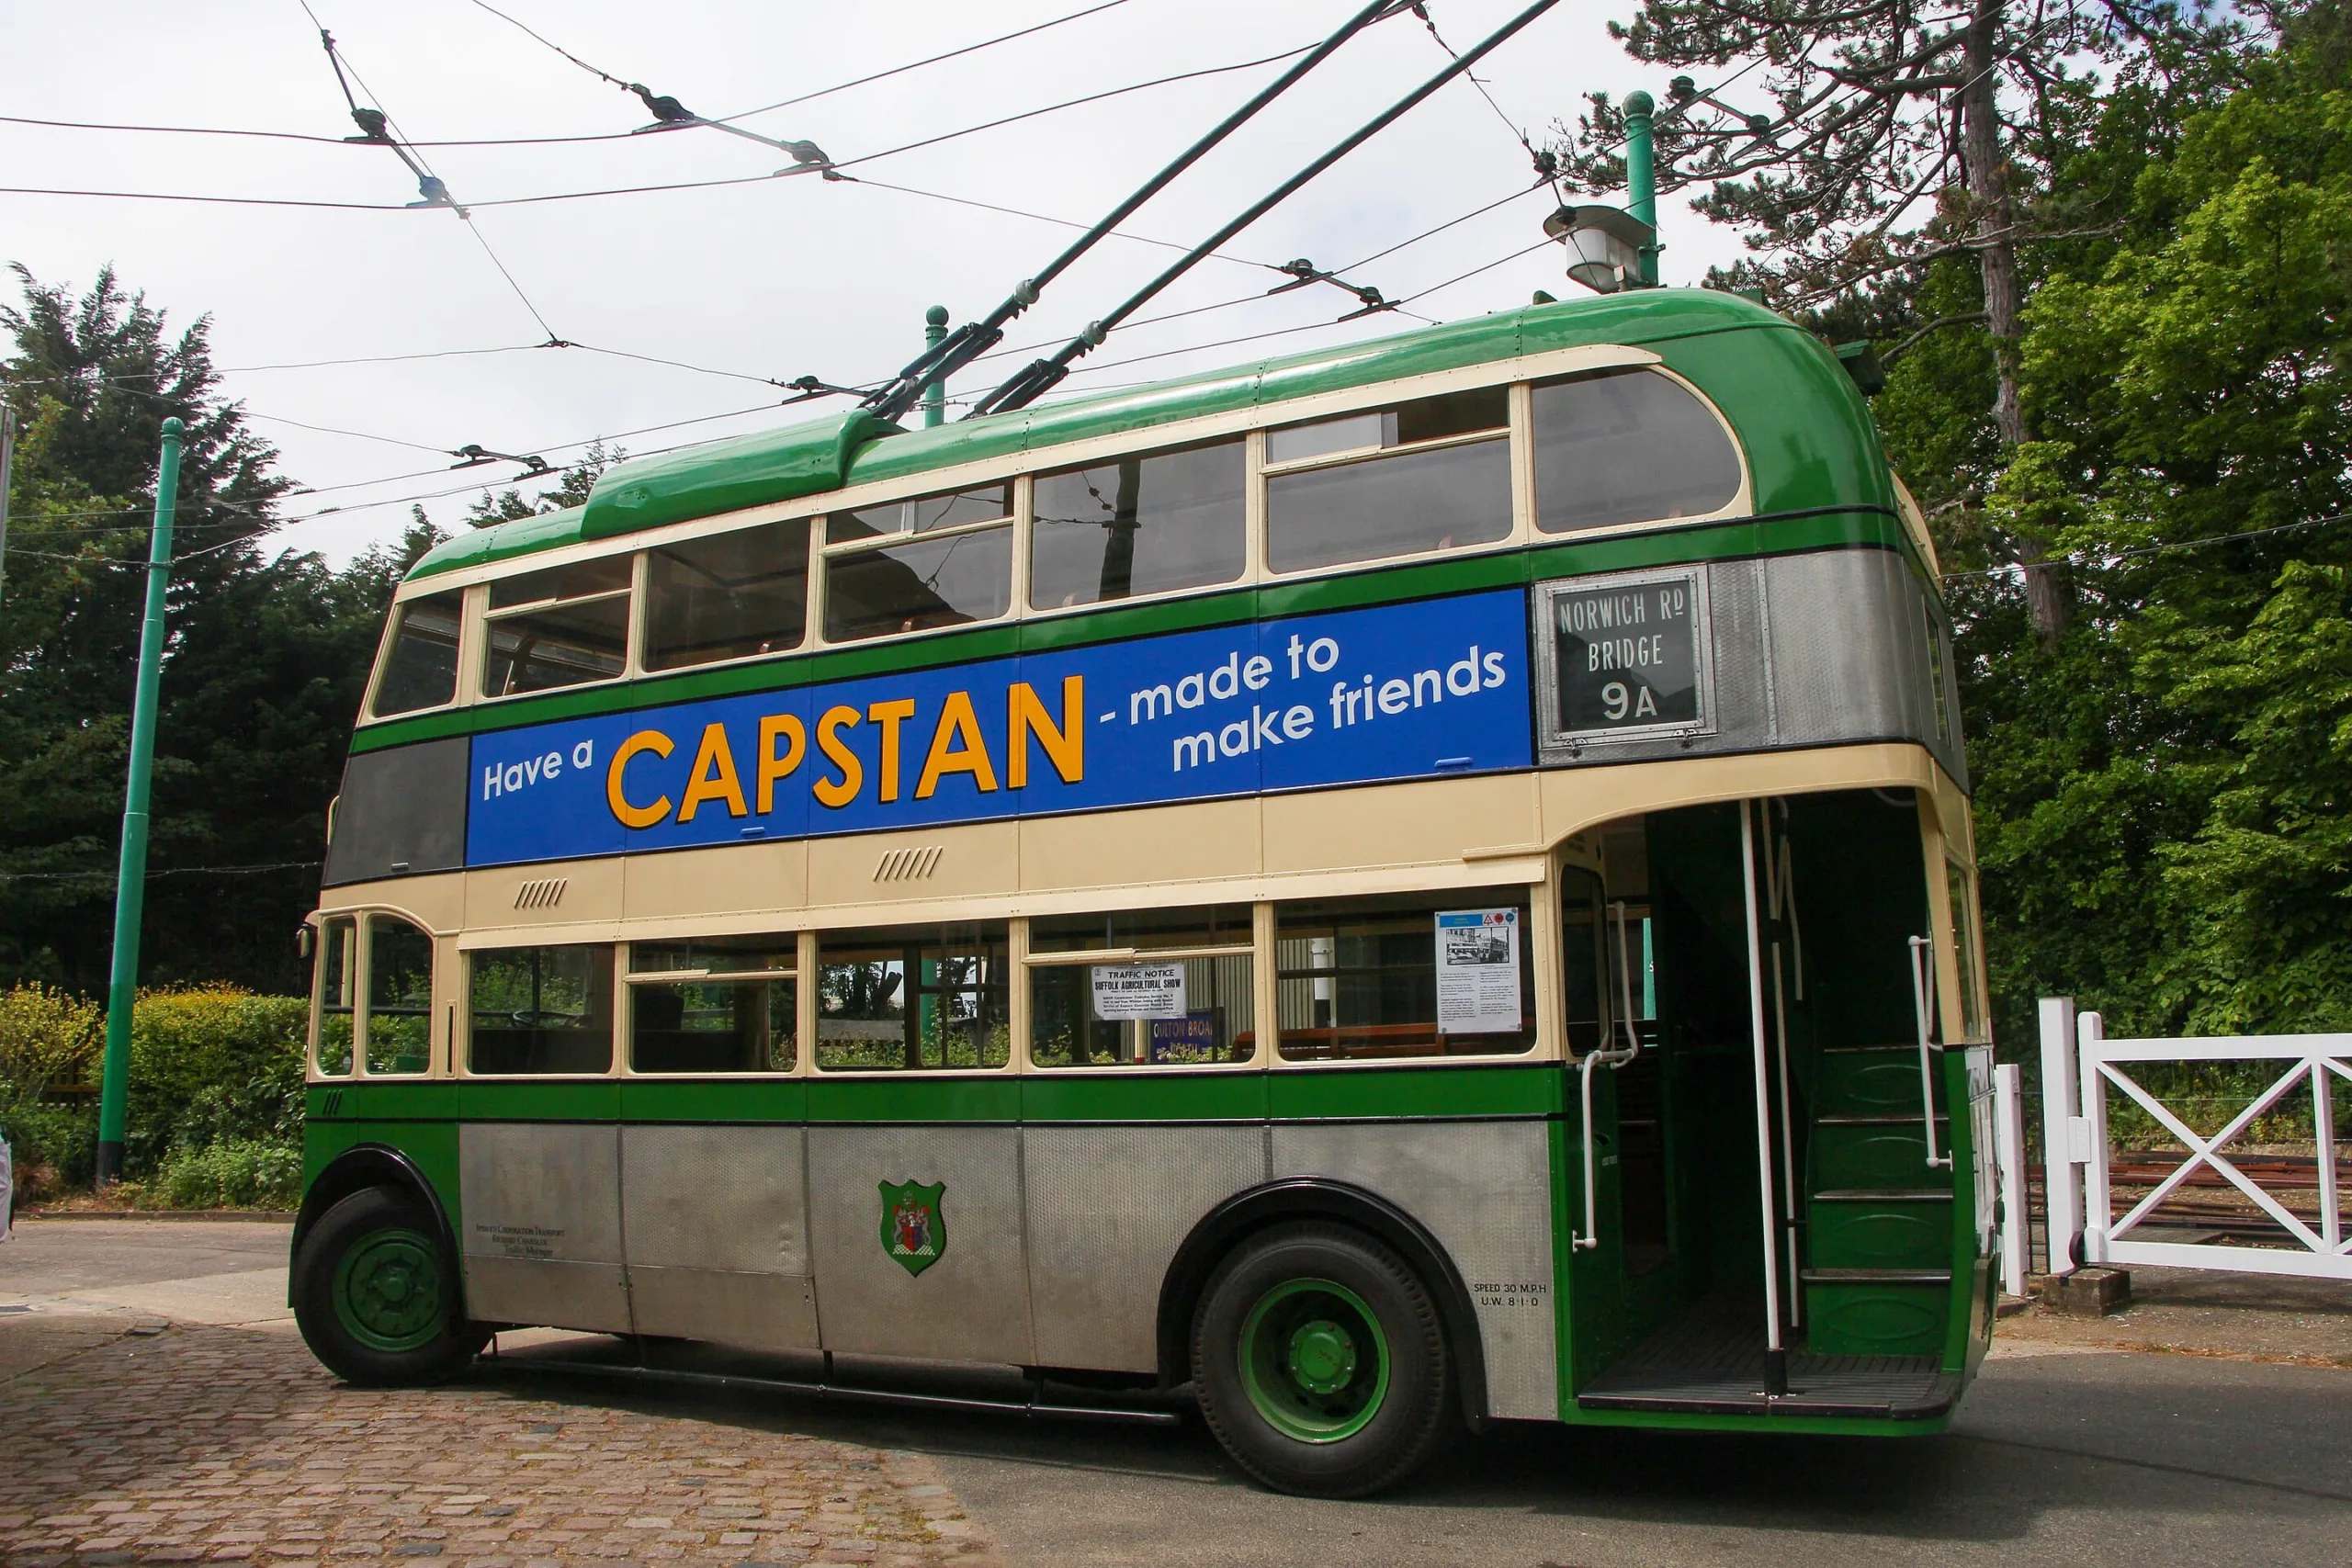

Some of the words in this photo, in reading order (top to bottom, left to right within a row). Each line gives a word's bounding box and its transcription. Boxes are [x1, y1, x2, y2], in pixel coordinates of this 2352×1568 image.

[1560, 592, 1645, 634] NORWICH
[1589, 634, 1663, 672] BRIDGE
[1172, 705, 1314, 773] make
[1329, 645, 1506, 729] friends
[1601, 682, 1657, 720] 9A
[483, 750, 561, 801] Have
[571, 739, 594, 771] a
[605, 674, 1084, 830] CAPSTAN
[1130, 650, 1272, 726] made
[1287, 633, 1340, 681] to
[1094, 981, 1119, 990] SUFFOLK
[1121, 979, 1161, 990] AGRICULTURAL
[1163, 978, 1181, 988] SHOW
[1108, 971, 1141, 979] TRAFFIC
[1144, 969, 1174, 978] NOTICE
[1154, 1021, 1185, 1038] OULTON
[1188, 1021, 1213, 1037] BROA
[1474, 1283, 1500, 1292] SPEED
[1504, 1284, 1516, 1293] 30
